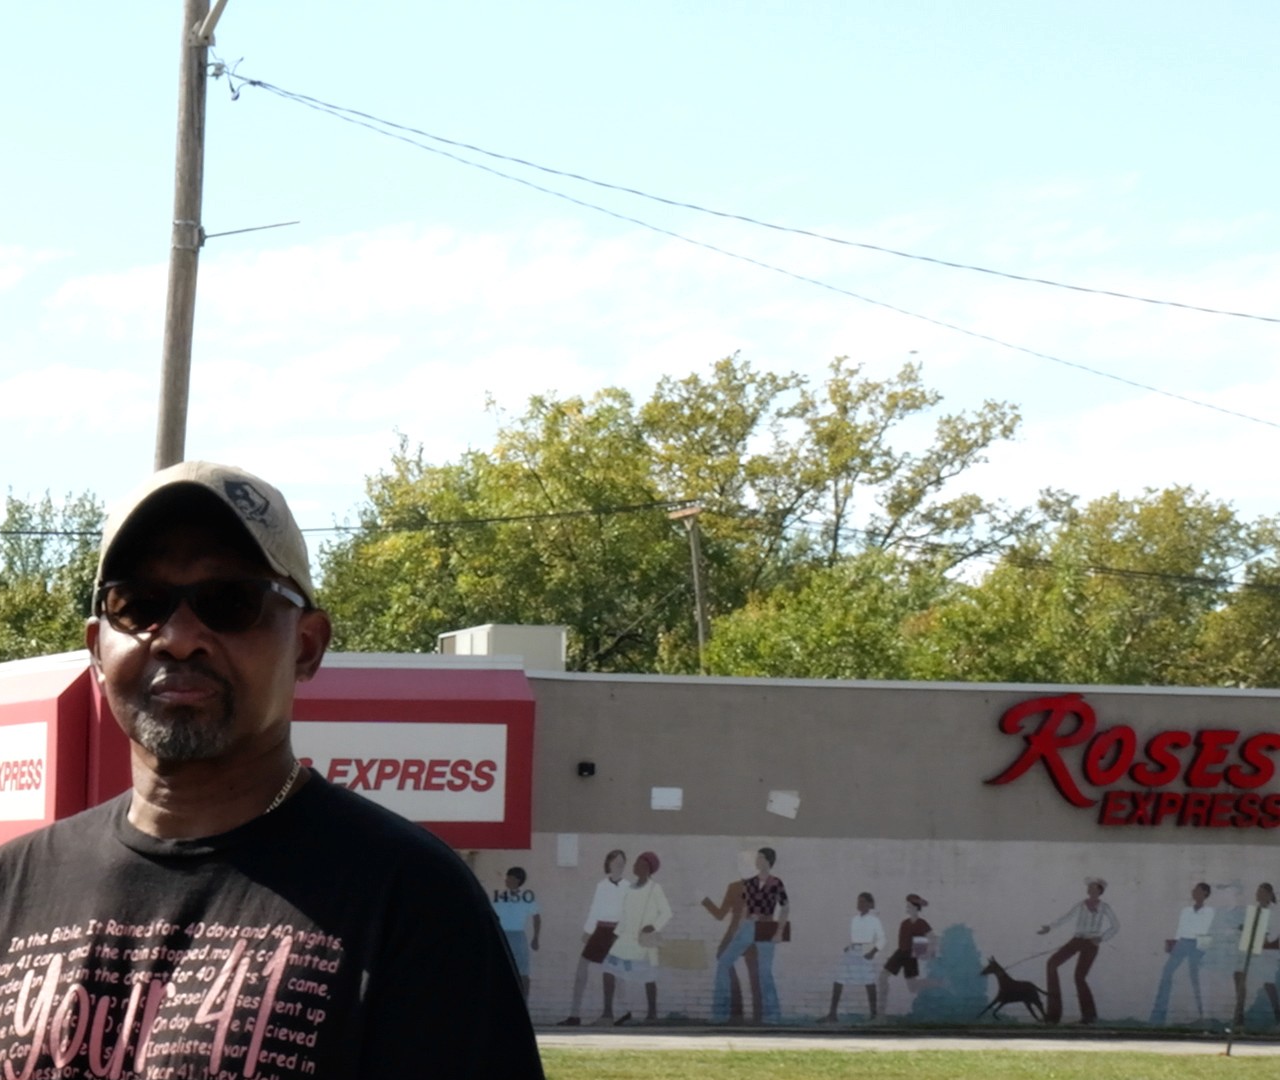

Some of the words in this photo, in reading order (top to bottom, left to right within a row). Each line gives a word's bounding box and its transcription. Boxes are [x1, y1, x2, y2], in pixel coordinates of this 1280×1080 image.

[327, 757, 498, 792] EXPRESS
[1098, 791, 1280, 829] EXPRESS
[493, 889, 535, 903] 1450
[8, 938, 23, 952] In
[27, 932, 48, 948] the
[86, 919, 103, 935] It
[106, 919, 155, 937] Rained
[156, 919, 180, 935] for
[185, 922, 205, 938] 40
[206, 922, 239, 941] days
[241, 923, 270, 939] and
[294, 930, 344, 951] nights.
[17, 955, 30, 970] 41
[68, 945, 91, 961] and
[95, 945, 118, 959] the
[123, 945, 148, 961] rain
[95, 969, 118, 983] the
[172, 968, 192, 983] for
[196, 966, 215, 982] 40
[197, 936, 294, 1078] 41
[307, 1009, 326, 1025] up
[152, 1017, 167, 1033] On
[169, 1014, 192, 1033] day
[301, 1056, 316, 1074] in
